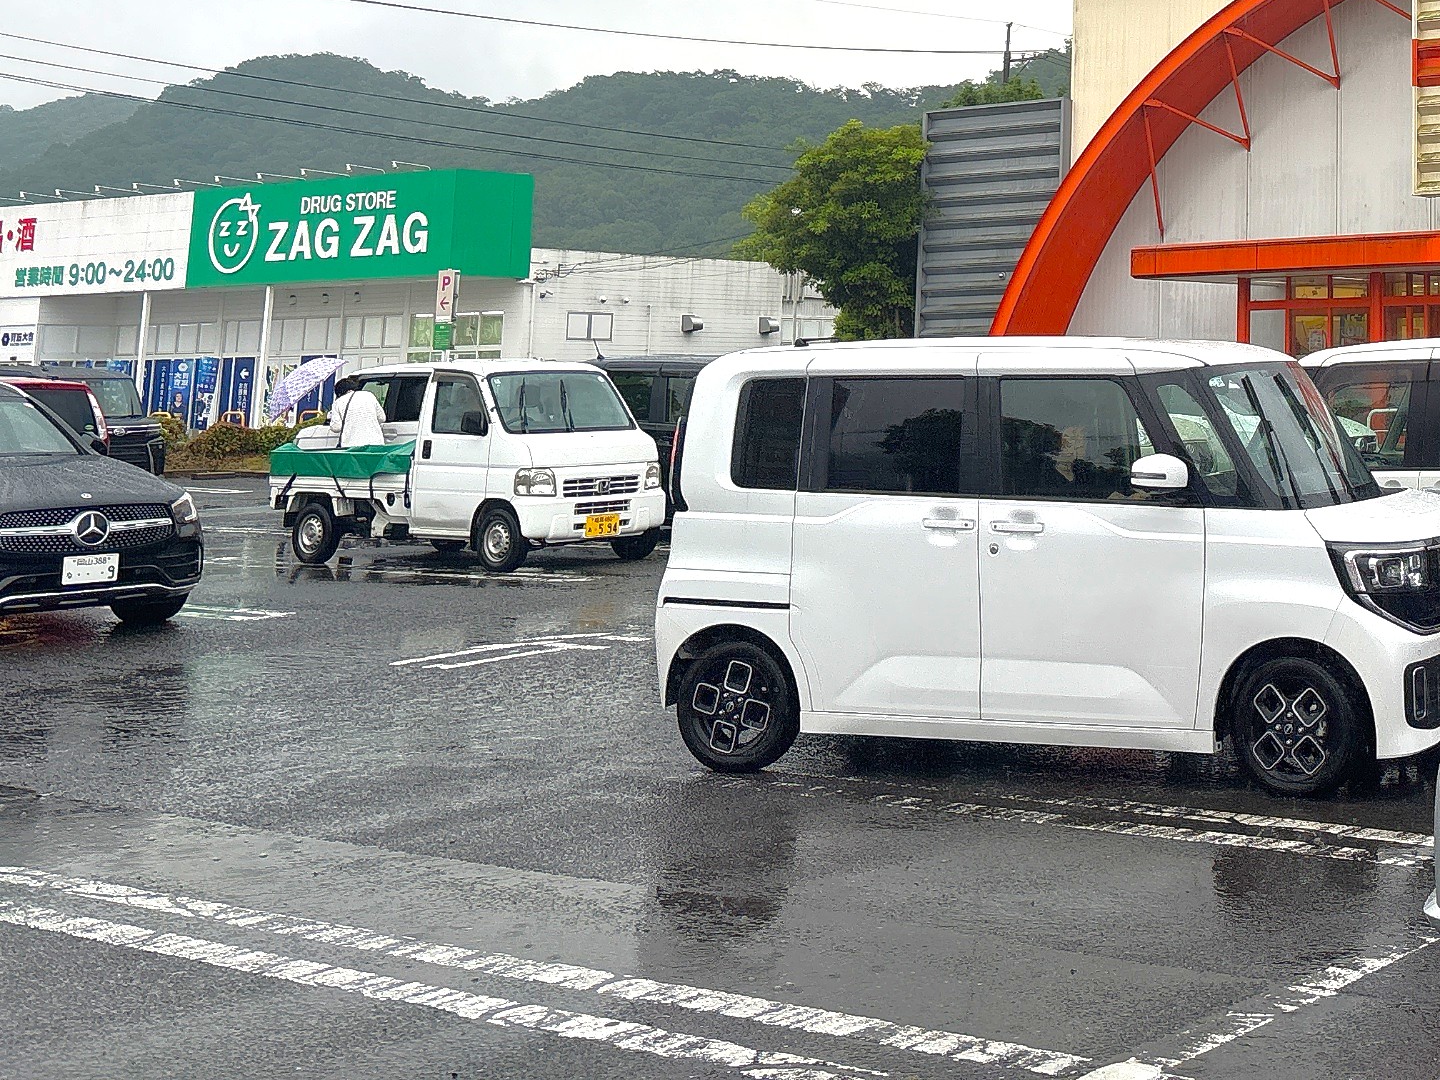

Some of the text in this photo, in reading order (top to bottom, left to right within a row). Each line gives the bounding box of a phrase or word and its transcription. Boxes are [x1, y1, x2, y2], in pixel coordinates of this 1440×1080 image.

[300, 190, 397, 215] DRUG STORE
[0, 217, 38, 254] ・酒
[264, 211, 429, 262] ZAG ZAG
[15, 265, 65, 288] 営業時間
[442, 275, 451, 291] P
